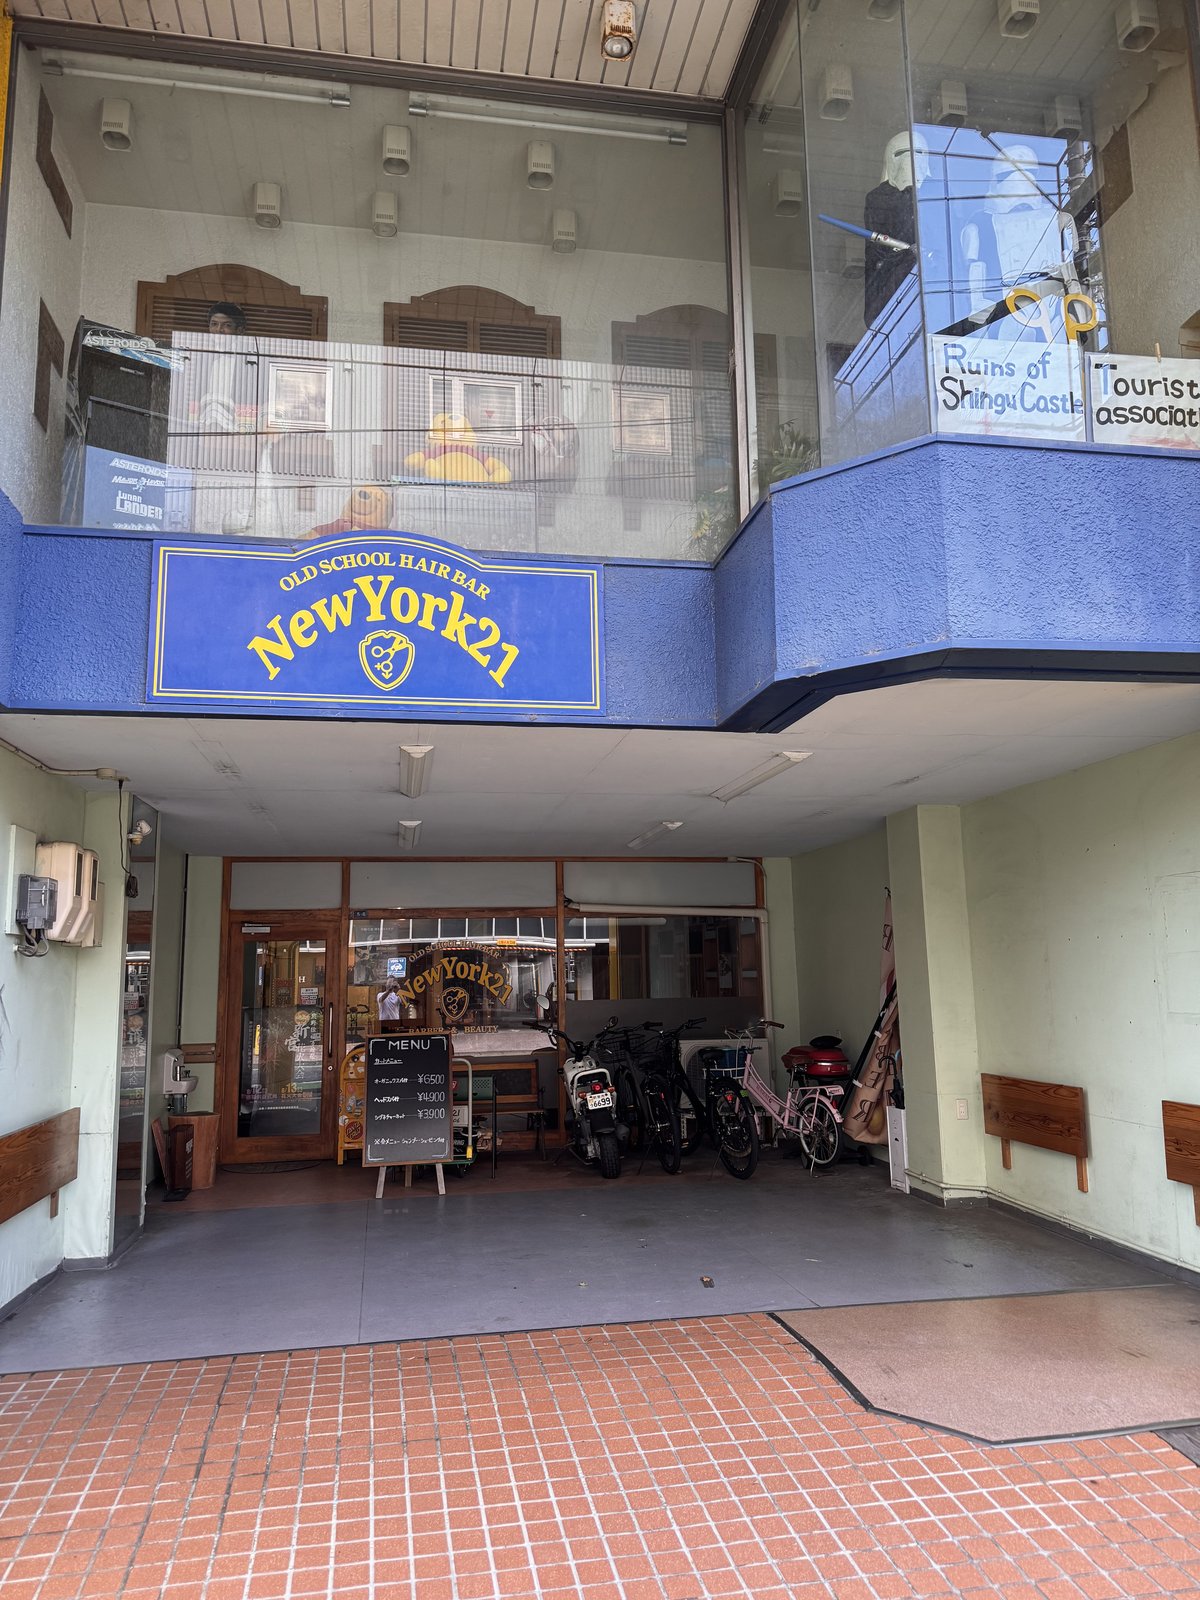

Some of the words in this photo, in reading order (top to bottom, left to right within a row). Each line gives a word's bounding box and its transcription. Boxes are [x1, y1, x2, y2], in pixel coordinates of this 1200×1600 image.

[84, 336, 147, 349] ASTEROIDS
[943, 343, 1015, 377] Ruins
[1027, 351, 1052, 379] of
[1094, 363, 1200, 400] Tourist
[940, 376, 1016, 415] Shingu
[1020, 382, 1083, 414] Castle
[1095, 404, 1200, 429] associat
[110, 458, 168, 478] ASTEROIDS
[279, 564, 318, 592] OLD
[318, 552, 396, 575] SCHOOL
[398, 553, 451, 580] HAIR
[451, 568, 492, 600] BAR
[408, 949, 426, 963] OLD
[482, 945, 501, 959] BAR
[464, 1025, 499, 1034] BEAUTY
[388, 1040, 430, 1050] MENU
[594, 1097, 611, 1107] 6699
